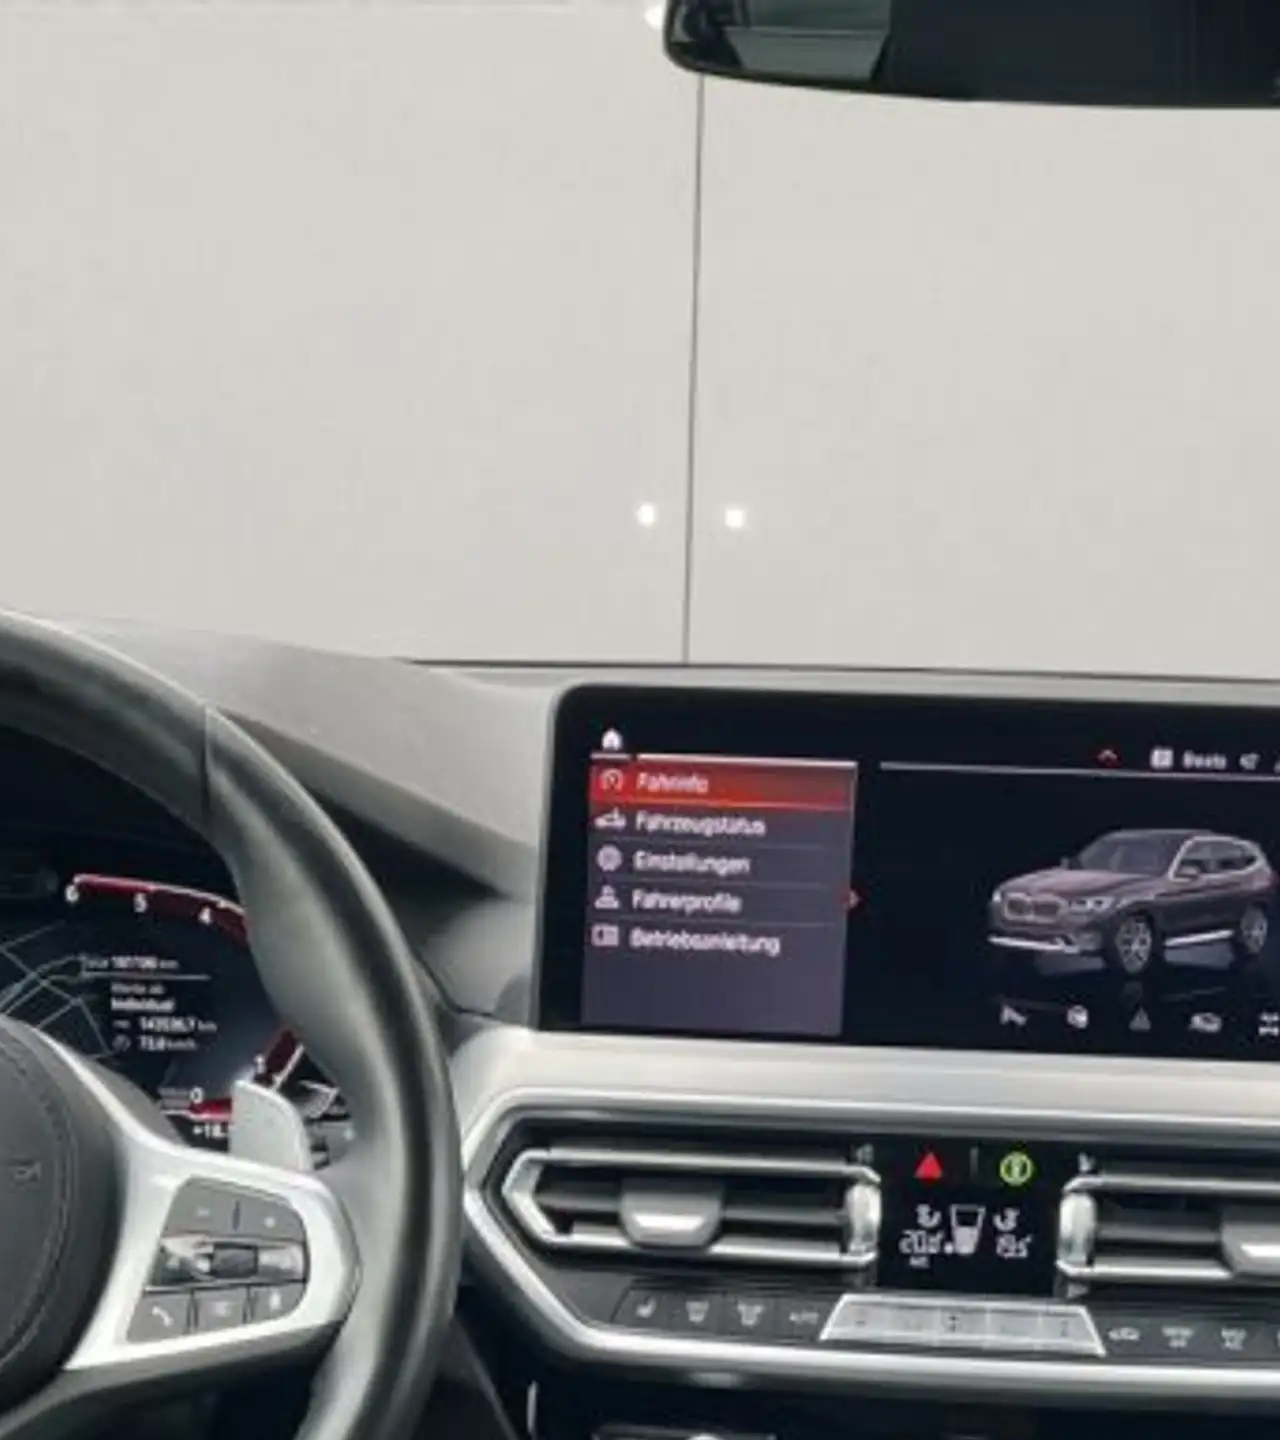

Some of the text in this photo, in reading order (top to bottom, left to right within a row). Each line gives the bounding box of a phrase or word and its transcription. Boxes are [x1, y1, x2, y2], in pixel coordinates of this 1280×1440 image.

[637, 773, 709, 793] Fahrinfo
[636, 811, 766, 836] Fahrzeugstatus
[633, 851, 750, 875] Einstellungen
[632, 890, 742, 914] Fahrerprofile
[198, 906, 213, 925] 4
[630, 928, 780, 957] Betriebsanleitung
